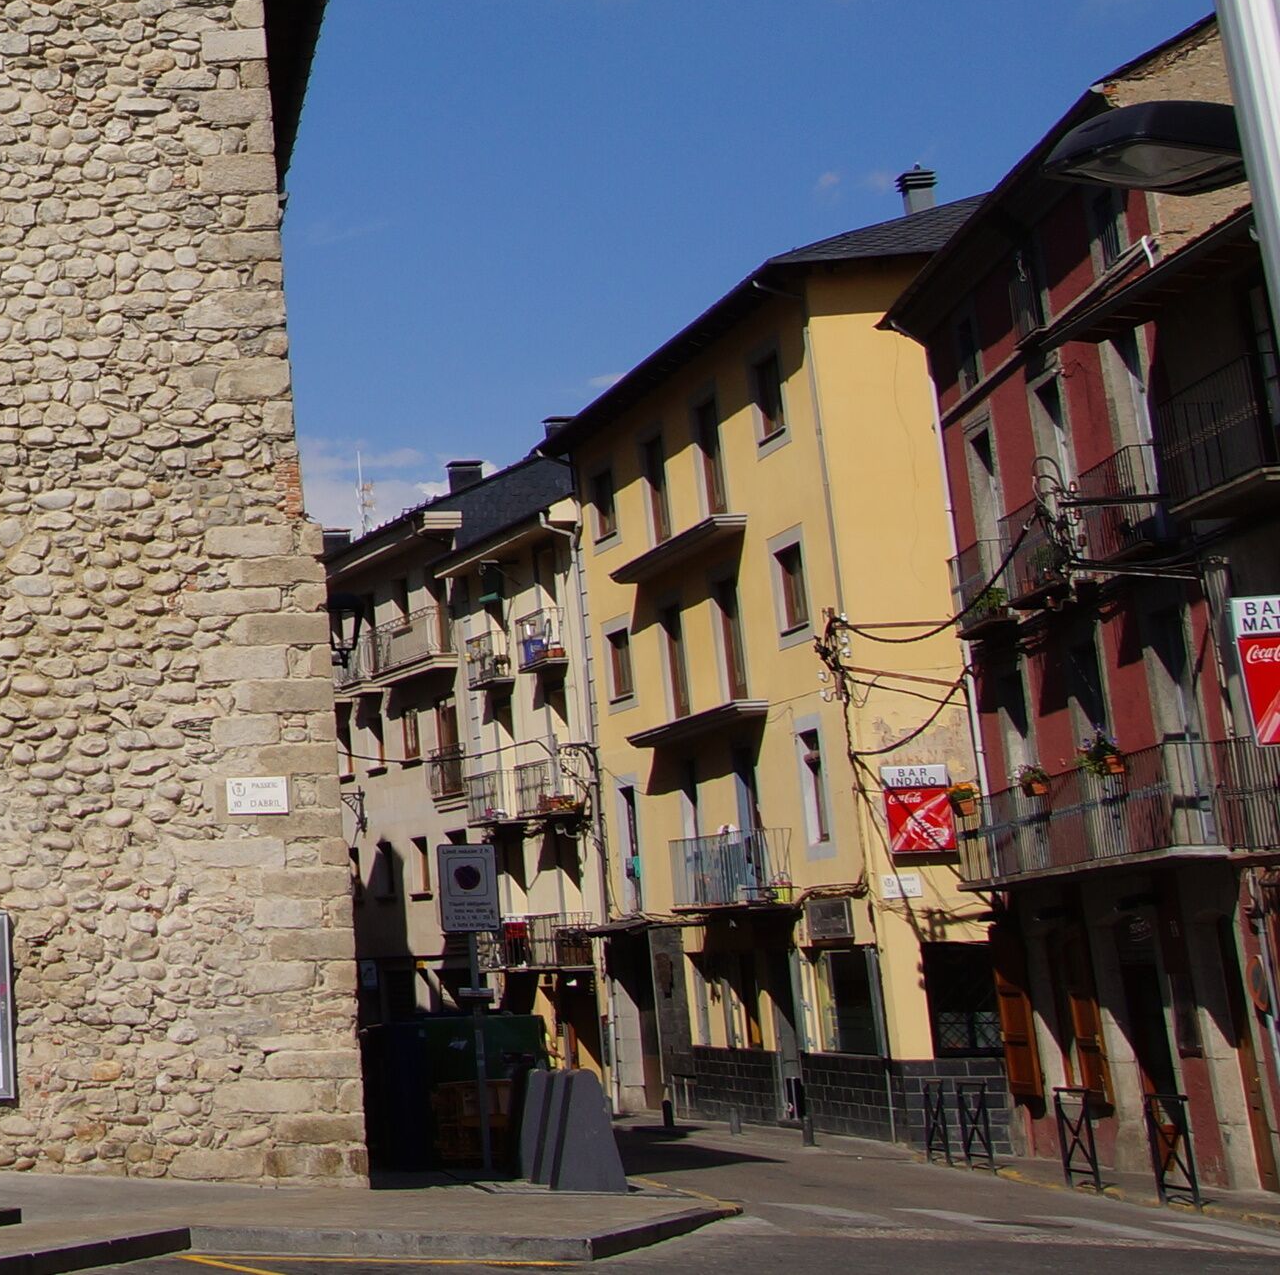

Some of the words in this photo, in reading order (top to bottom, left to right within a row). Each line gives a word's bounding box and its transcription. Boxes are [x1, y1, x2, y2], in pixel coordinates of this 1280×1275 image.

[1244, 600, 1280, 616] BA
[898, 767, 927, 777] BAR
[891, 776, 937, 787] INDALO
